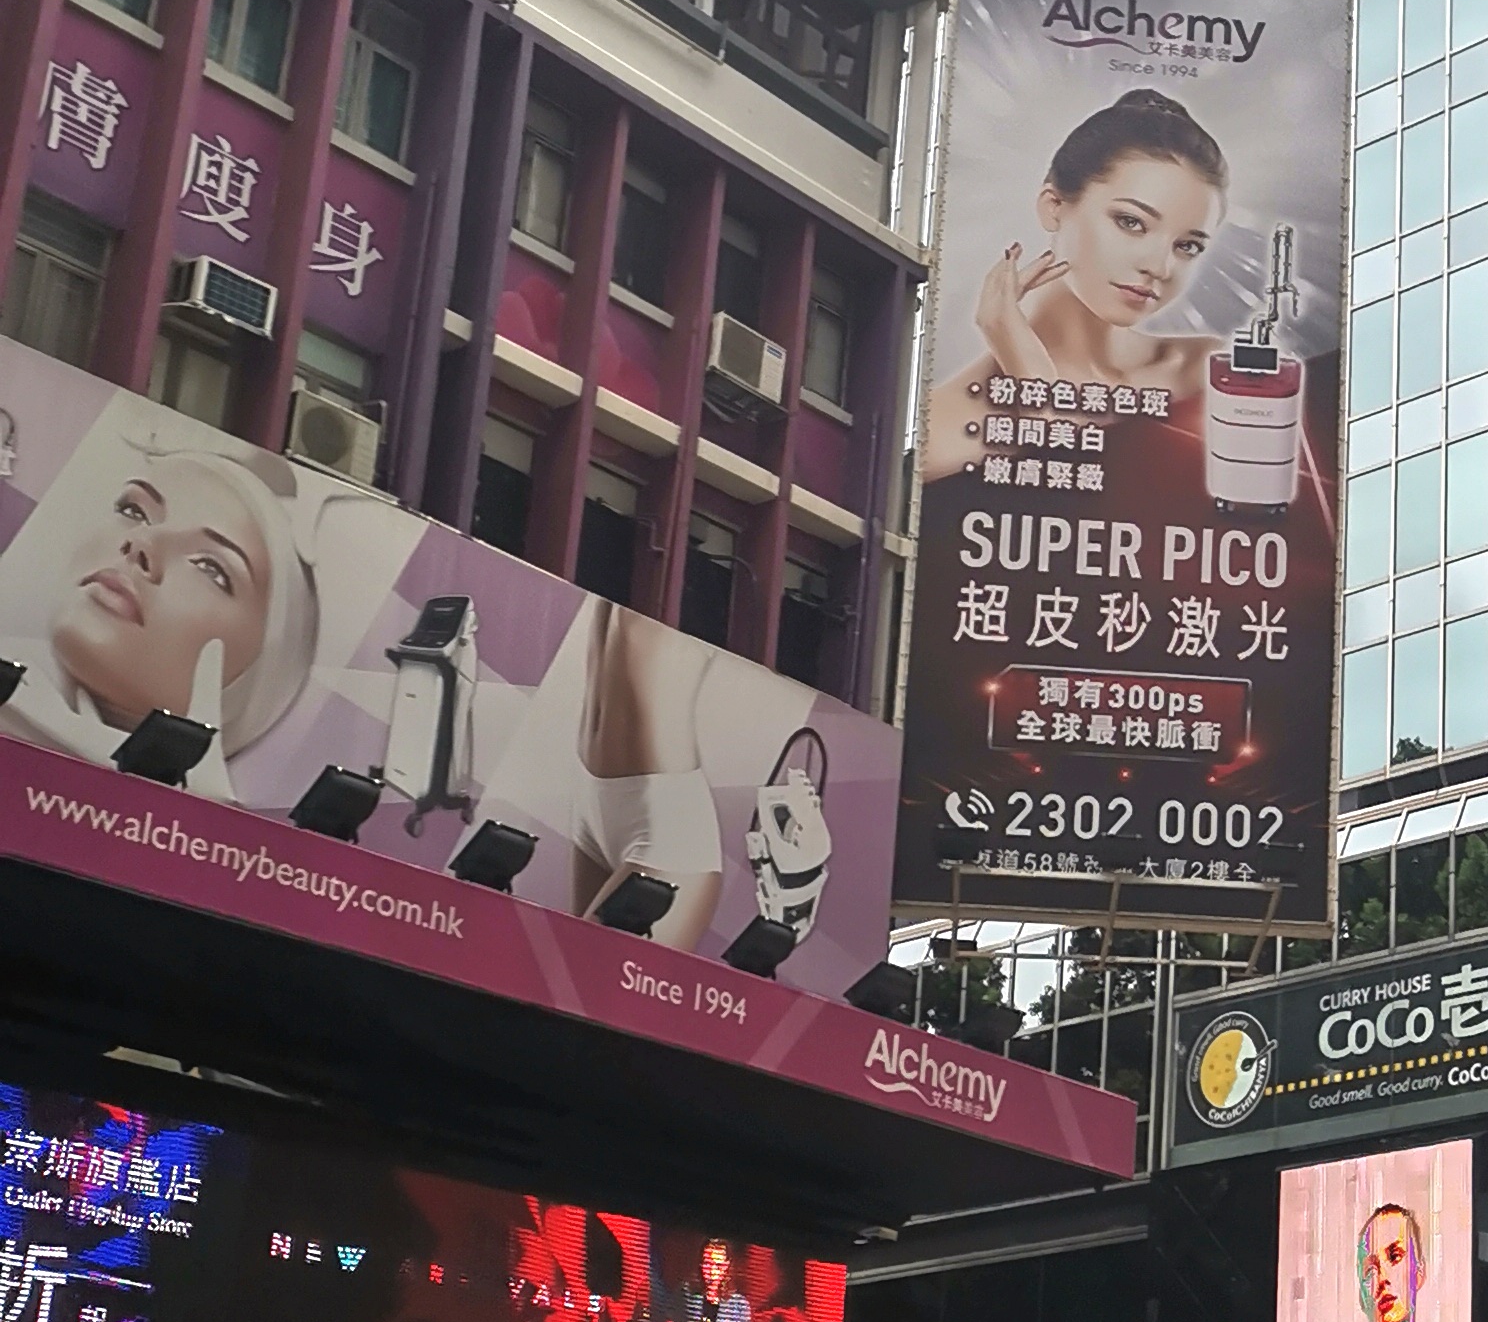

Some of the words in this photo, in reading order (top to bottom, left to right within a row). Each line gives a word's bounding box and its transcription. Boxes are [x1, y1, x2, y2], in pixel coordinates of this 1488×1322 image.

[1108, 58, 1155, 75] Since
[1160, 63, 1199, 78] 1994
[988, 375, 1170, 417] 粉碎色素色斑
[985, 416, 1105, 452] 瞬間美白
[959, 511, 1142, 579] SUPER
[1162, 524, 1289, 588] PICO
[953, 579, 1290, 661] 超皮秒激光
[1038, 675, 1204, 717] 獨有300ps
[1016, 709, 1222, 752] 全球最快脈衝
[1005, 791, 1134, 839] 2302
[1158, 800, 1284, 848] 0002
[26, 786, 464, 939] www.alchemybeauty.com.hk
[619, 960, 684, 1006] Since
[693, 981, 748, 1025] 1994
[1319, 986, 1371, 1013] CURRY
[1374, 973, 1432, 1003] HOUSE
[1318, 1000, 1435, 1059] CoCo
[864, 1028, 1007, 1123] Alchemy
[1308, 1089, 1341, 1110] Good
[1377, 1078, 1410, 1097] Good
